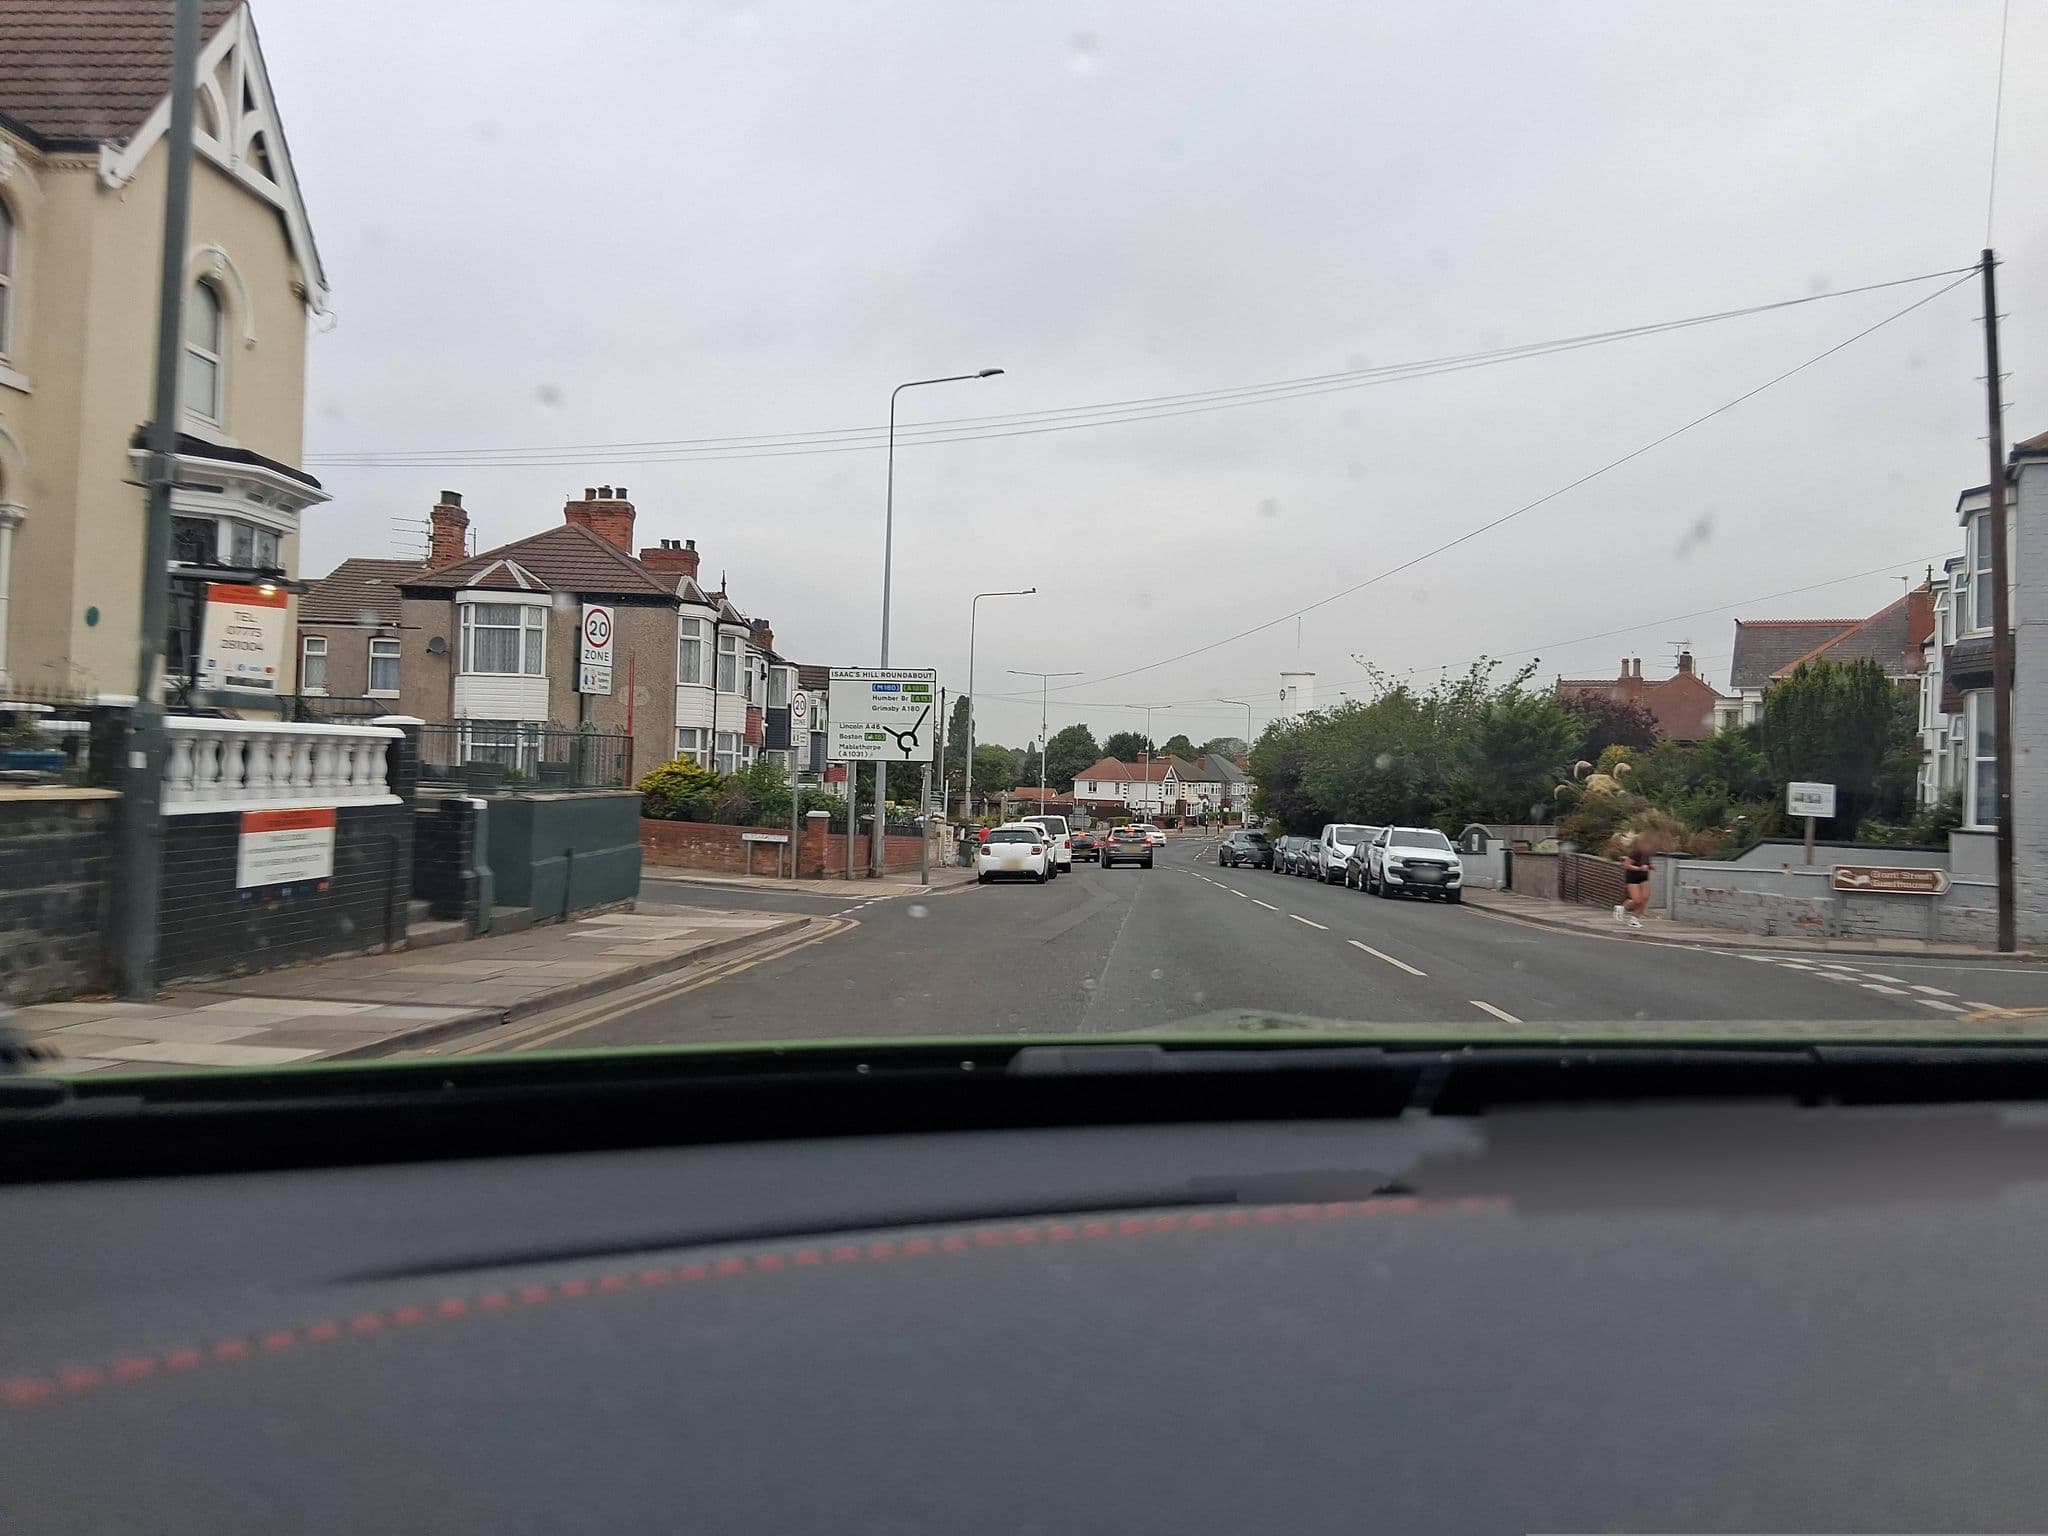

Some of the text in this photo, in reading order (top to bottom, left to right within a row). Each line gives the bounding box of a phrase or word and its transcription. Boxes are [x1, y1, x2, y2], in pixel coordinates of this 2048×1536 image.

[589, 620, 608, 637] 20
[584, 649, 610, 662] ZONE
[873, 684, 900, 692] (M180)
[795, 700, 805, 710] 20
[1902, 871, 1933, 881] Street
